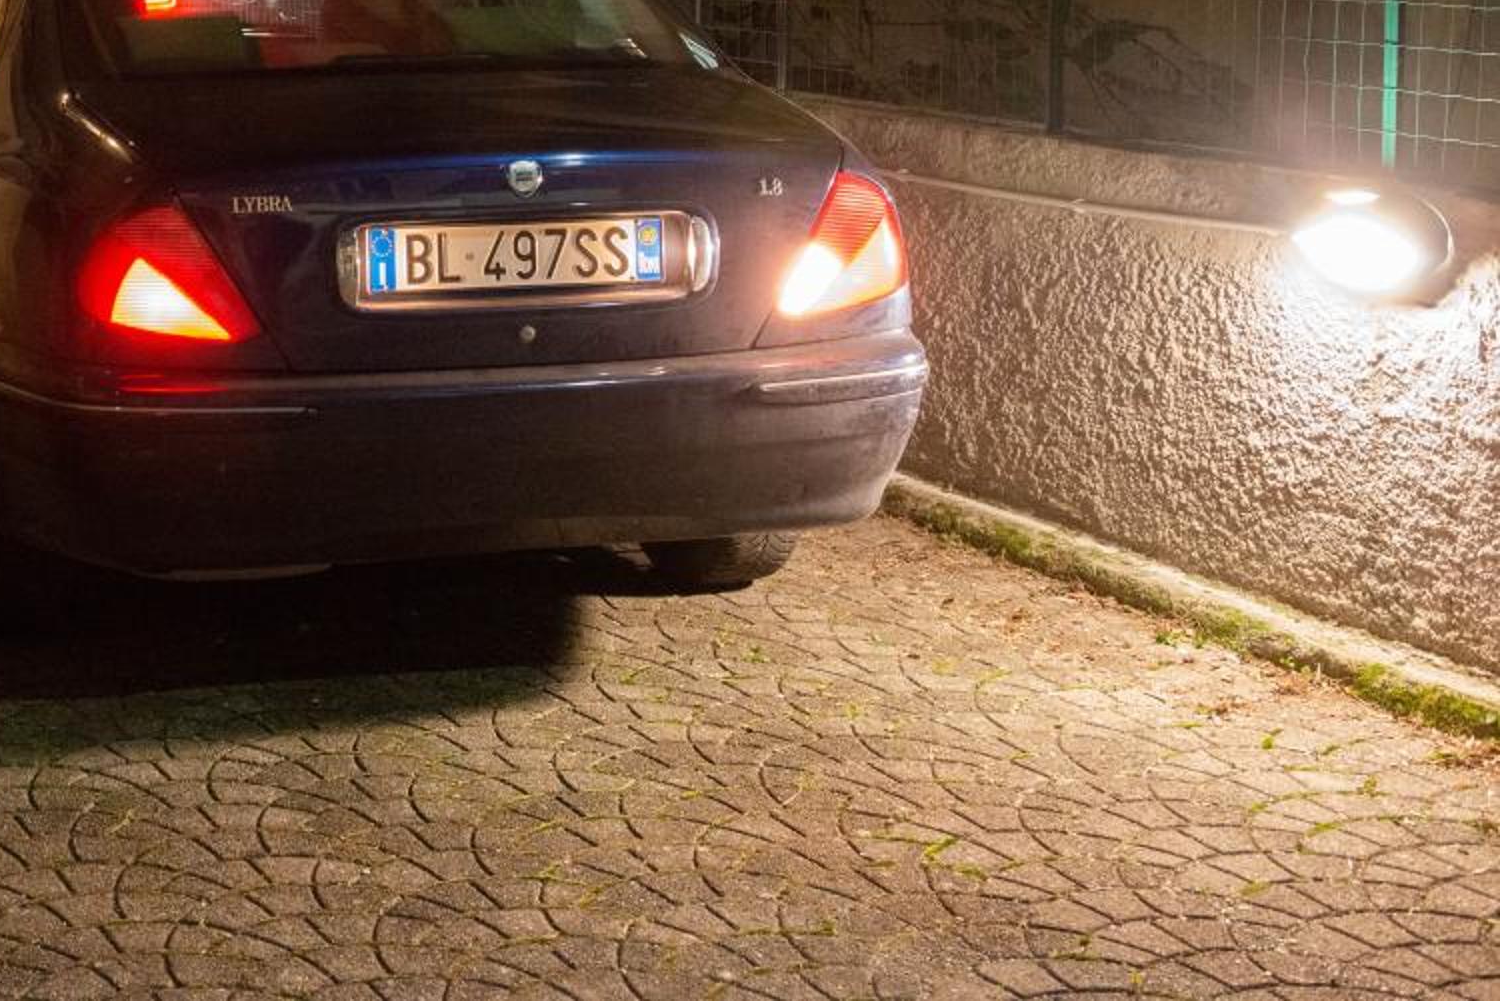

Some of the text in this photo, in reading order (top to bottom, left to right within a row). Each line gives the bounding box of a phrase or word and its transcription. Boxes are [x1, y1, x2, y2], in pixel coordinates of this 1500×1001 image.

[759, 177, 783, 197] 1.8
[232, 195, 293, 214] LYBRA
[406, 232, 461, 285] BL
[483, 227, 630, 280] 497SS
